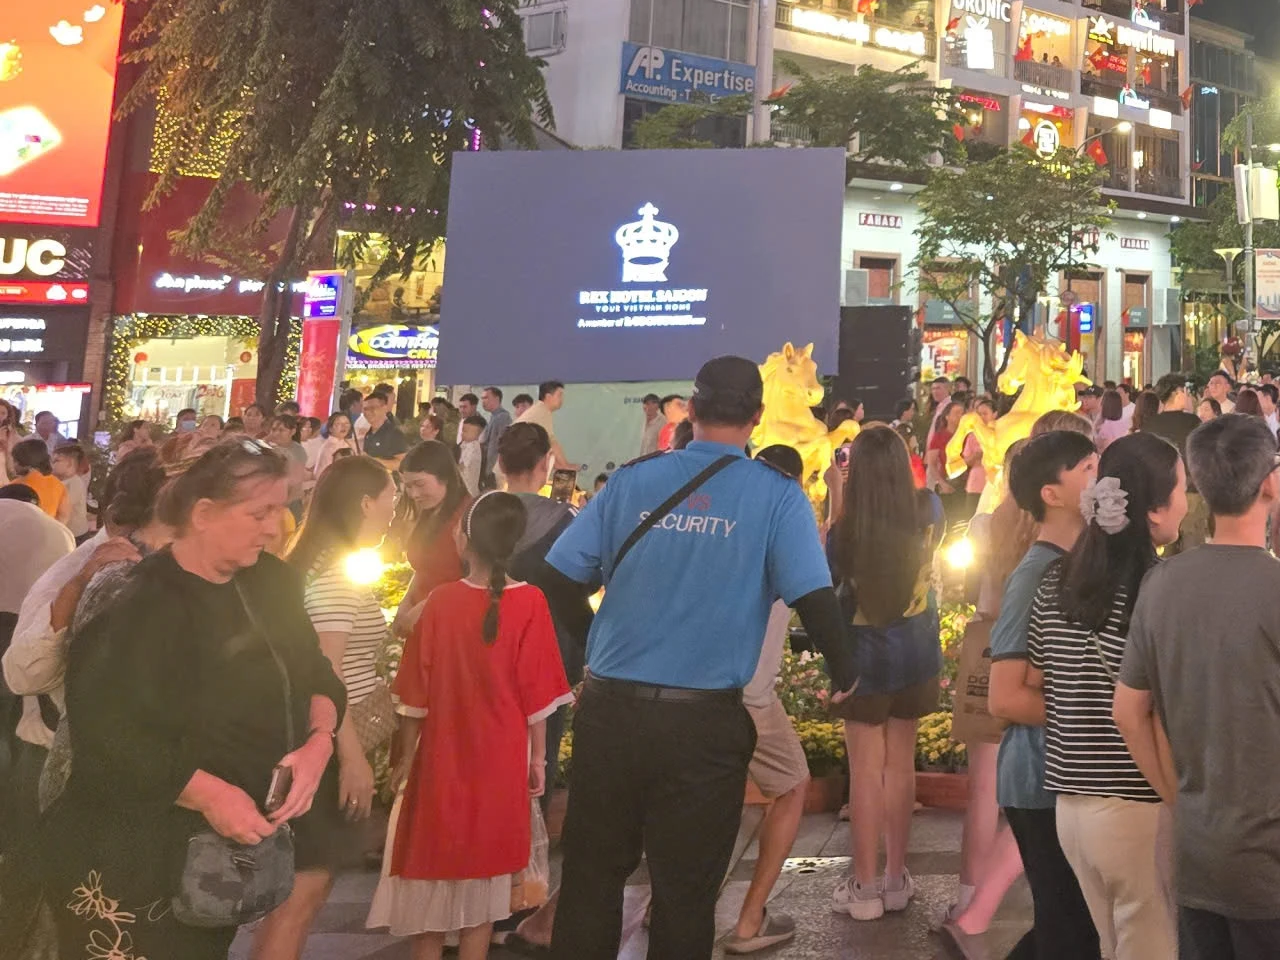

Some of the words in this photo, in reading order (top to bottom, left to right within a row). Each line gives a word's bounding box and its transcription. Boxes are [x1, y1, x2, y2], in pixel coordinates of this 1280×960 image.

[671, 58, 755, 94] Expertise
[625, 79, 677, 101] Accounting
[687, 494, 712, 511] VS
